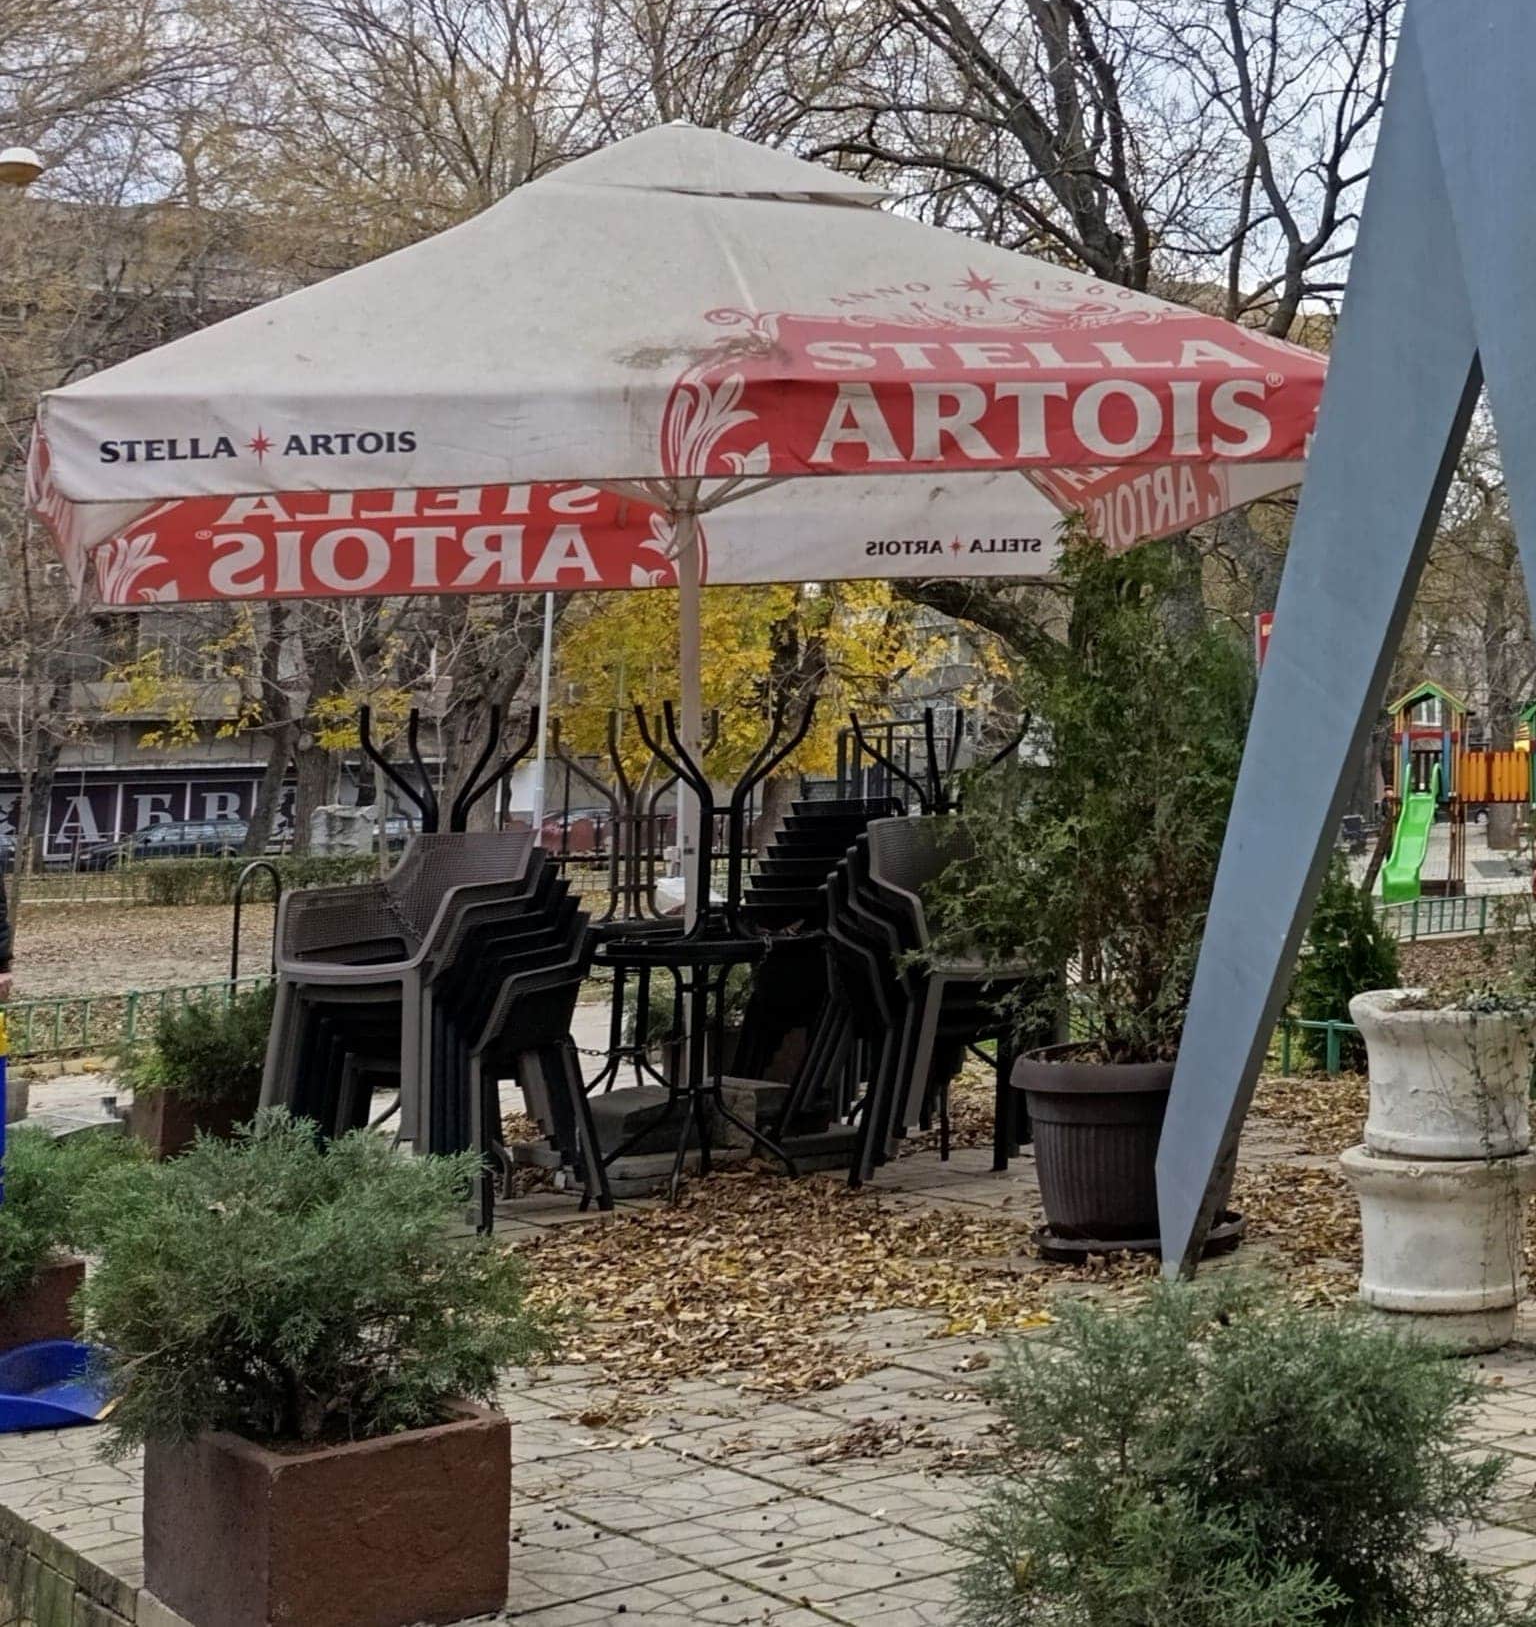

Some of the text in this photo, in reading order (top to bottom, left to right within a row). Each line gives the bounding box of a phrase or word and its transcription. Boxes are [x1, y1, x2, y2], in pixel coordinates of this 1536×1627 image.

[806, 340, 1262, 370] STELLA
[808, 379, 1272, 463] ARTOIS
[100, 431, 417, 464] STELLA ARTOIS
